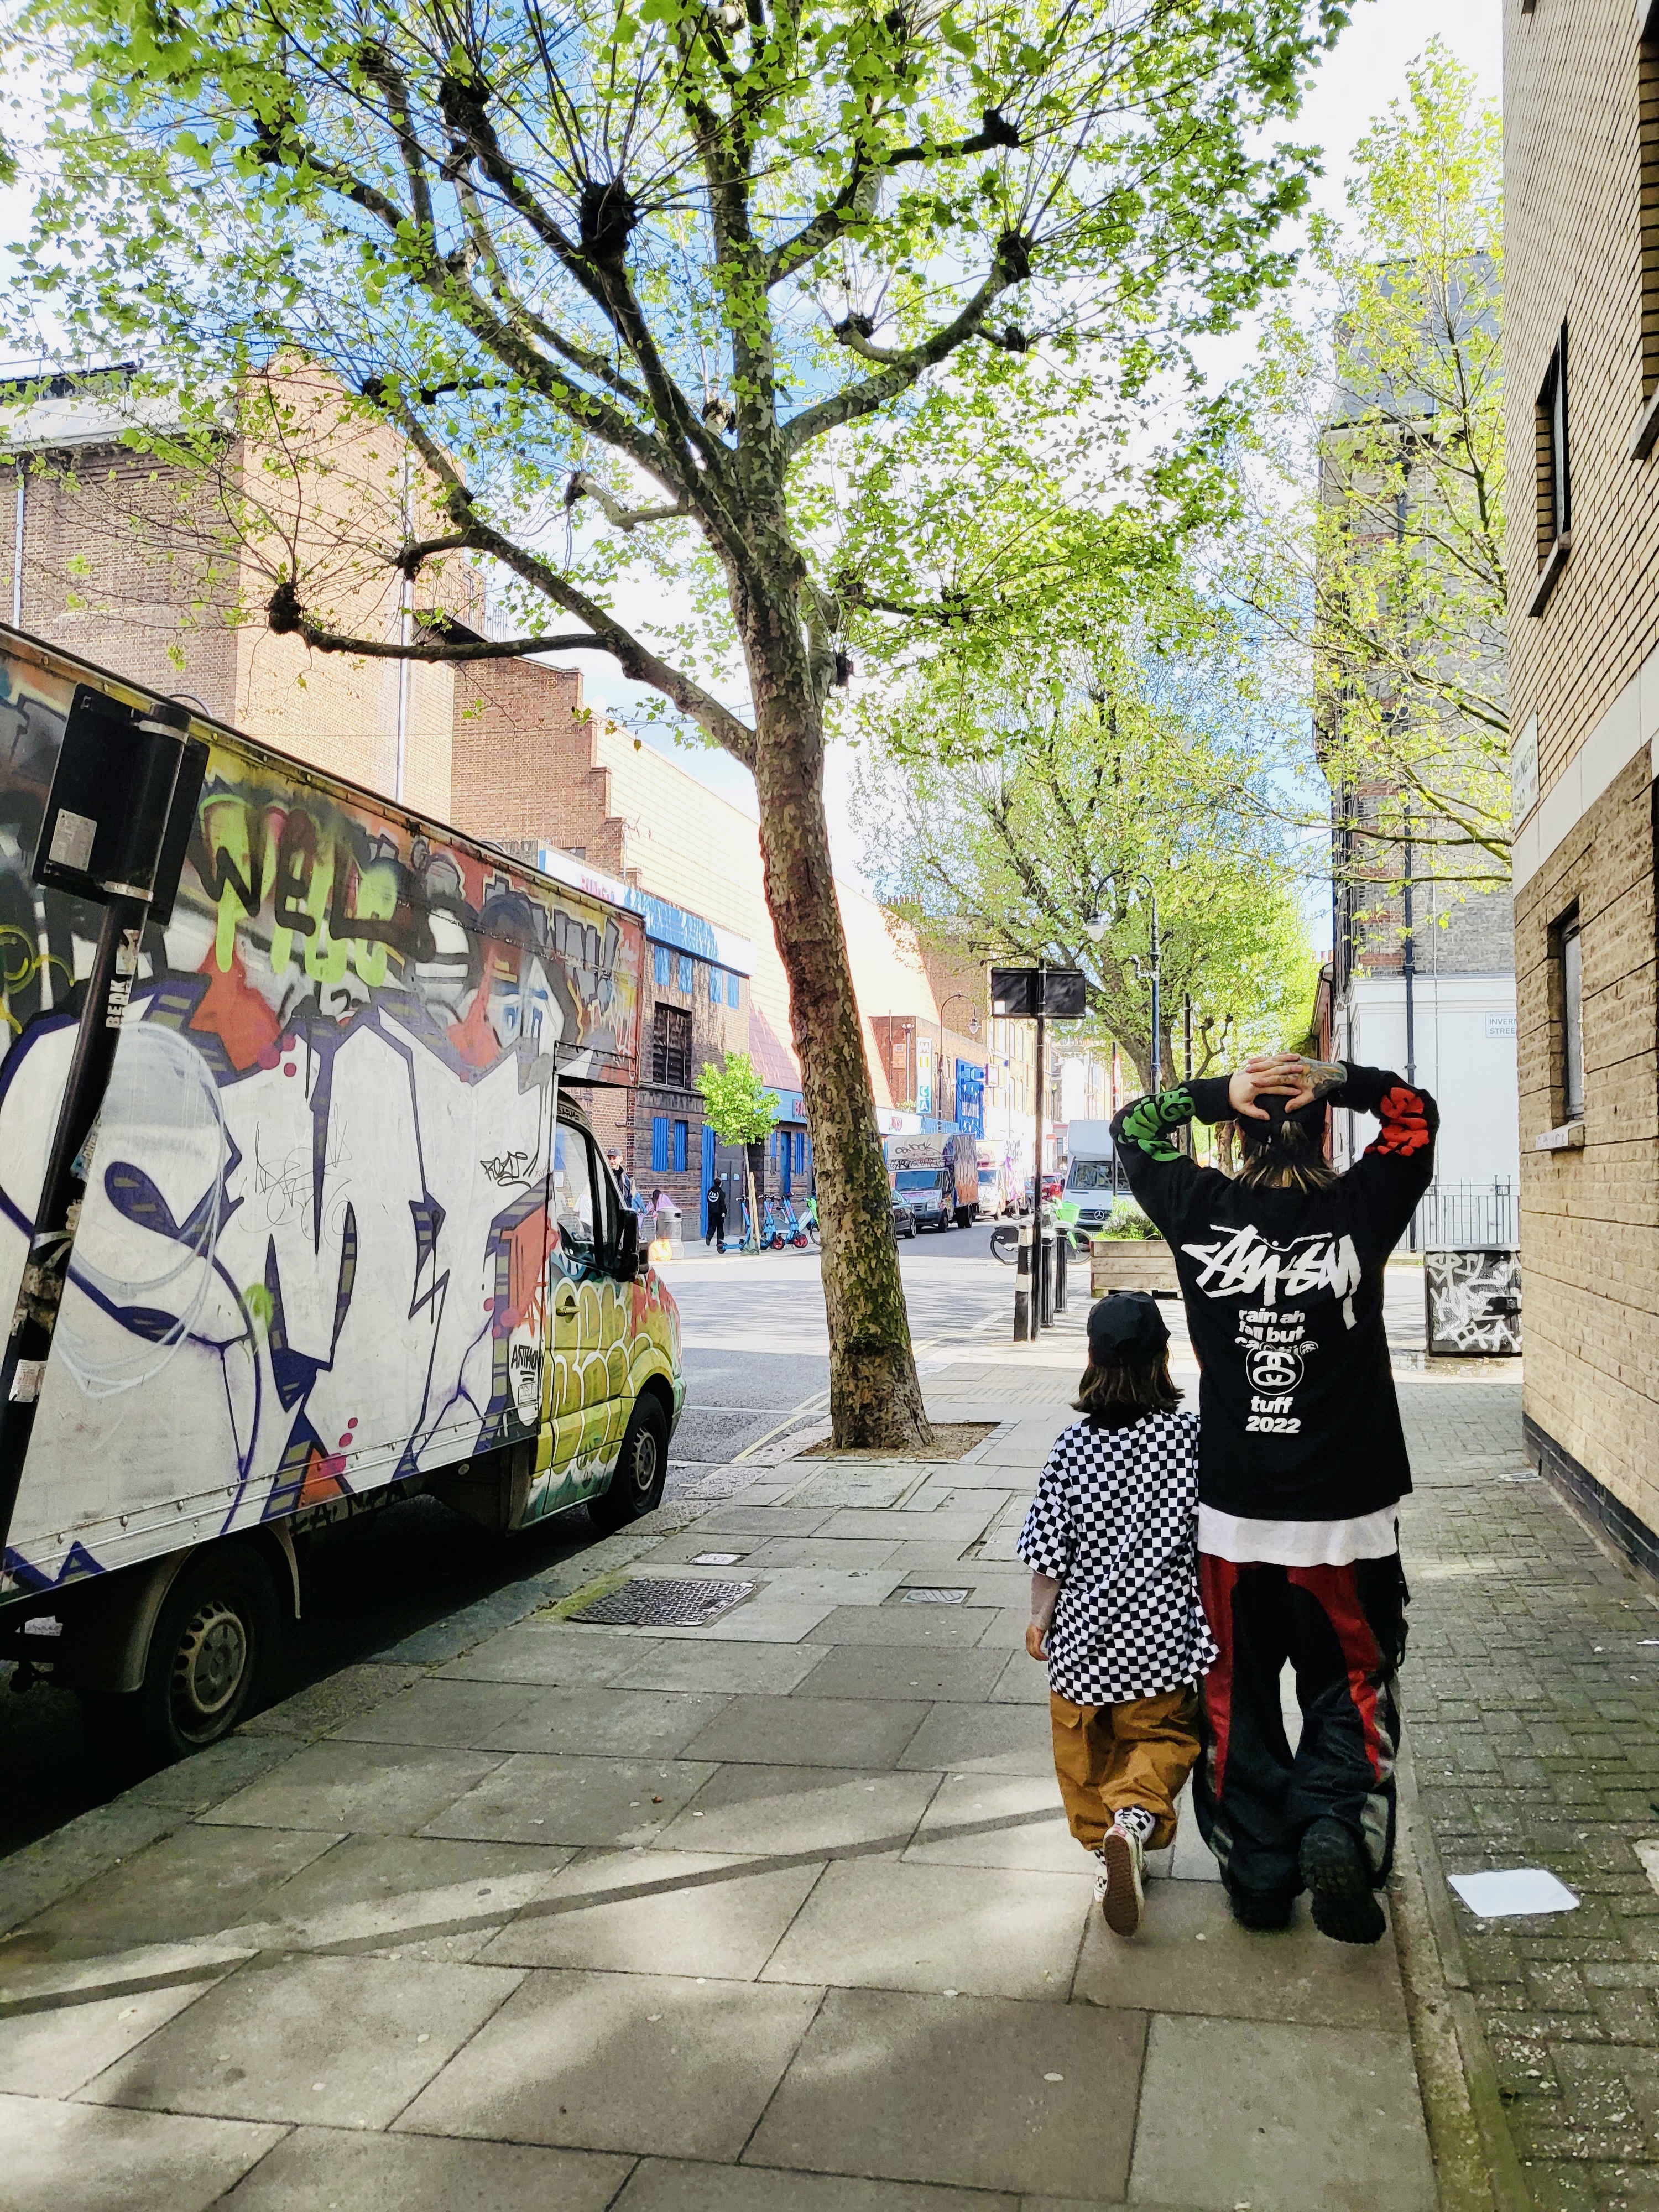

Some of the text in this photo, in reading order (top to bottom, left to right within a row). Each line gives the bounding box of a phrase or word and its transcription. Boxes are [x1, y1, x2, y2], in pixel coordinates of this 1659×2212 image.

[1239, 1308, 1306, 1324] rain ah
[1239, 1320, 1306, 1343] fall but
[1250, 1396, 1294, 1414] tuff
[1245, 1415, 1301, 1434] 2022
